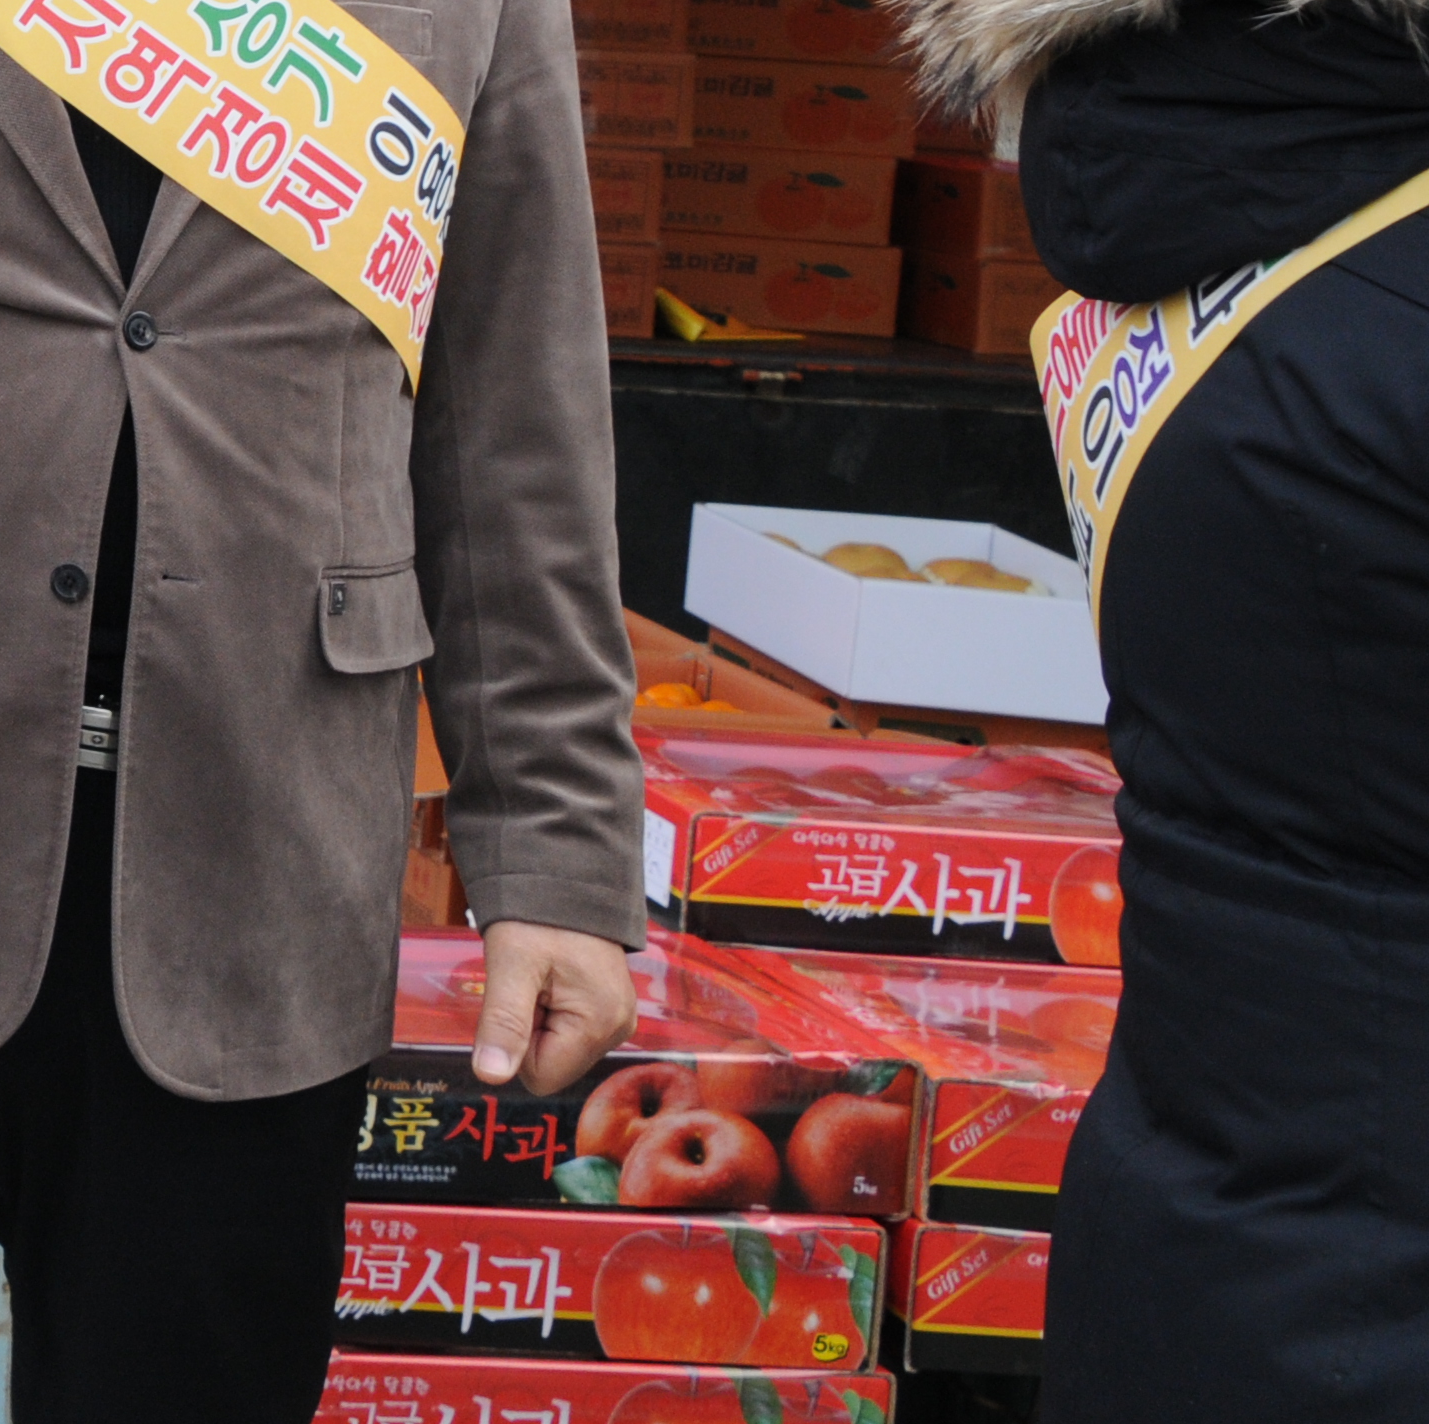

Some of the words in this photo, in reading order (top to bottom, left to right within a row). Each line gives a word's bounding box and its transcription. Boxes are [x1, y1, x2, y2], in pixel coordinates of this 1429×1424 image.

[368, 92, 459, 240] 이용
[1082, 307, 1172, 505] 정이
[702, 843, 734, 874] Gift
[734, 827, 759, 853] Set
[414, 1078, 449, 1094] Apple
[949, 1125, 984, 1155] Gift
[983, 1103, 1013, 1132] Set
[926, 1269, 962, 1301] Gift
[961, 1249, 991, 1277] Set
[812, 1334, 847, 1356] 5kg
